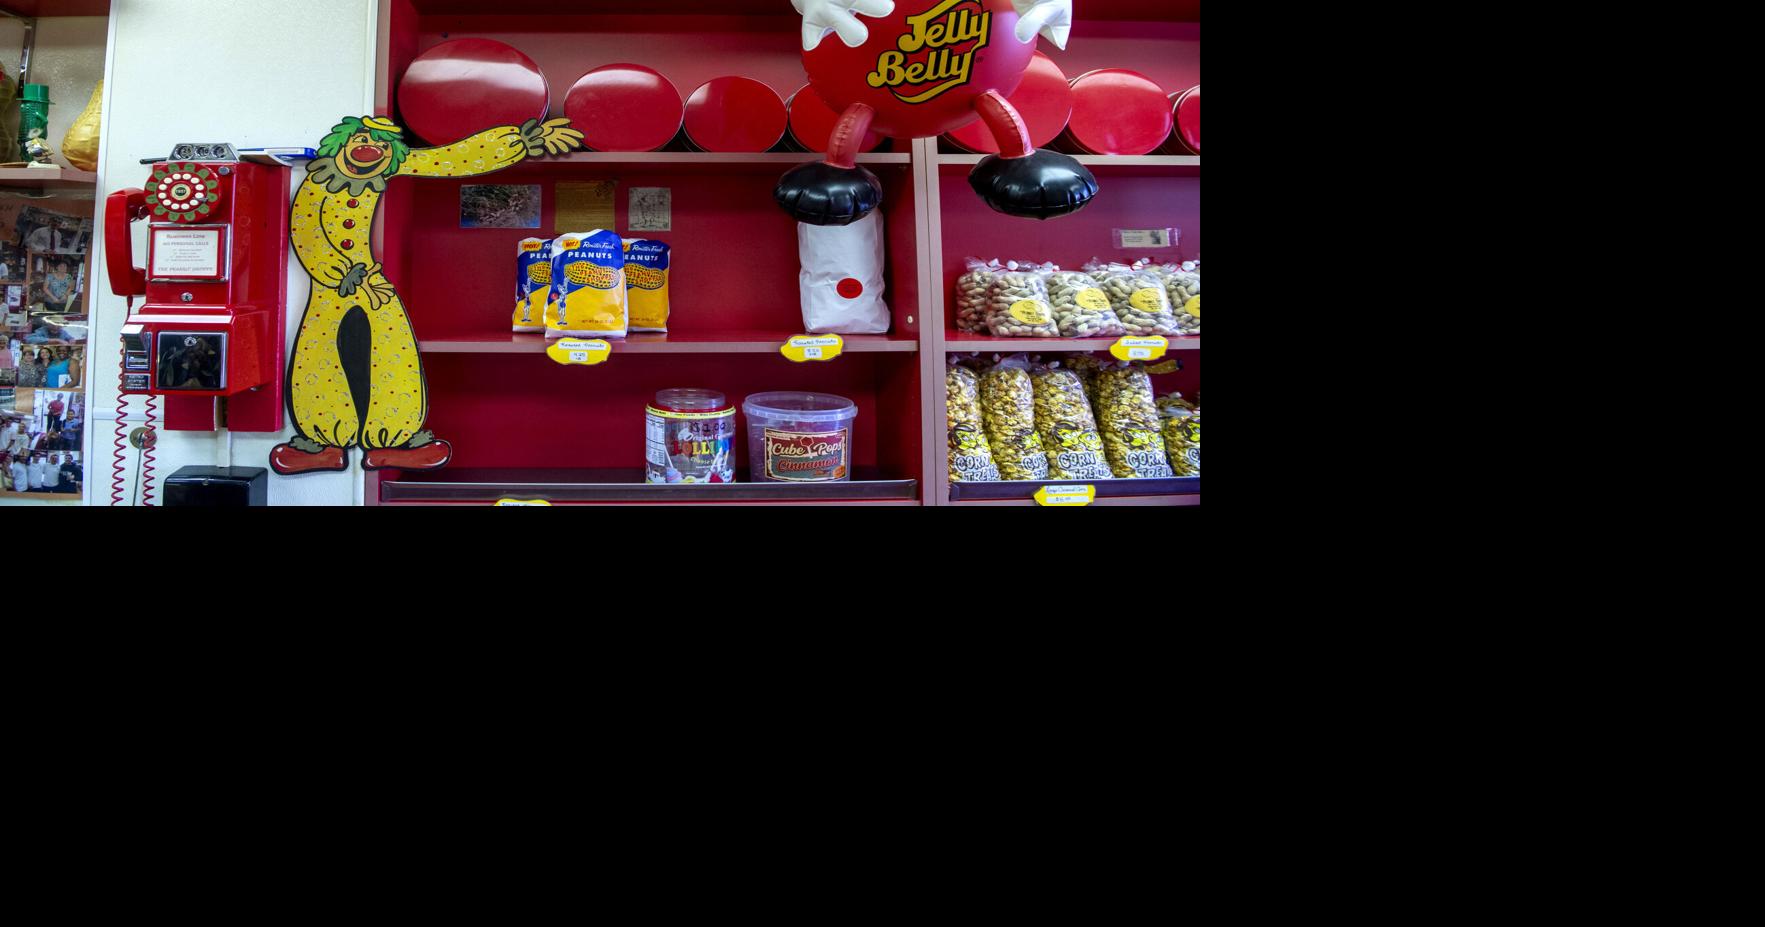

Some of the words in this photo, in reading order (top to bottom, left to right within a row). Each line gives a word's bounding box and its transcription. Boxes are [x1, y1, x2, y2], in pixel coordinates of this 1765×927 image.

[898, 8, 989, 52] Jelly
[867, 48, 972, 87] Belly
[568, 251, 612, 259] PEANUTS
[772, 443, 806, 455] Cube
[813, 441, 842, 455] Pops
[776, 456, 840, 473] Cinnamon
[956, 454, 989, 472] CORN
[1058, 452, 1096, 469] CORN
[1127, 451, 1165, 468] CORN
